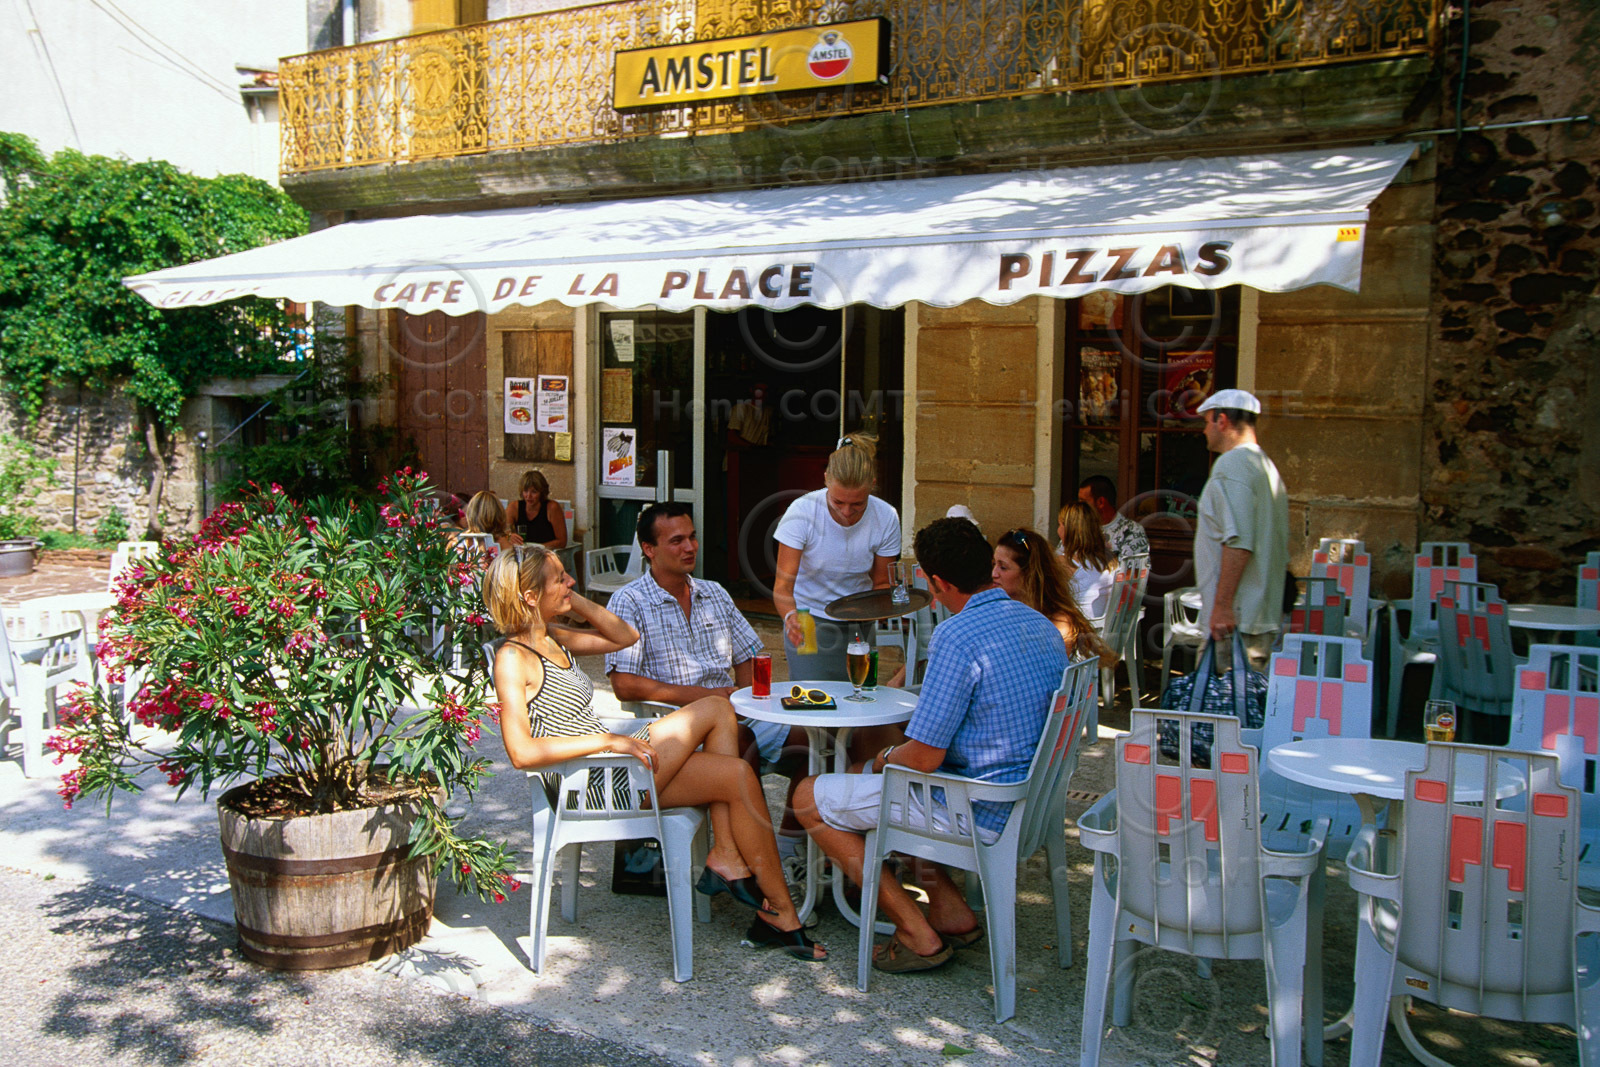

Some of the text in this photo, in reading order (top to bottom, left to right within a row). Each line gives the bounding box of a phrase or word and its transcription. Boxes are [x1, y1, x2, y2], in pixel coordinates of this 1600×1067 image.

[638, 47, 778, 98] AMSTEL
[812, 48, 848, 61] AMSTEL
[373, 263, 816, 303] CAFE DE LA PLACE
[998, 240, 1235, 291] PIZZAS
